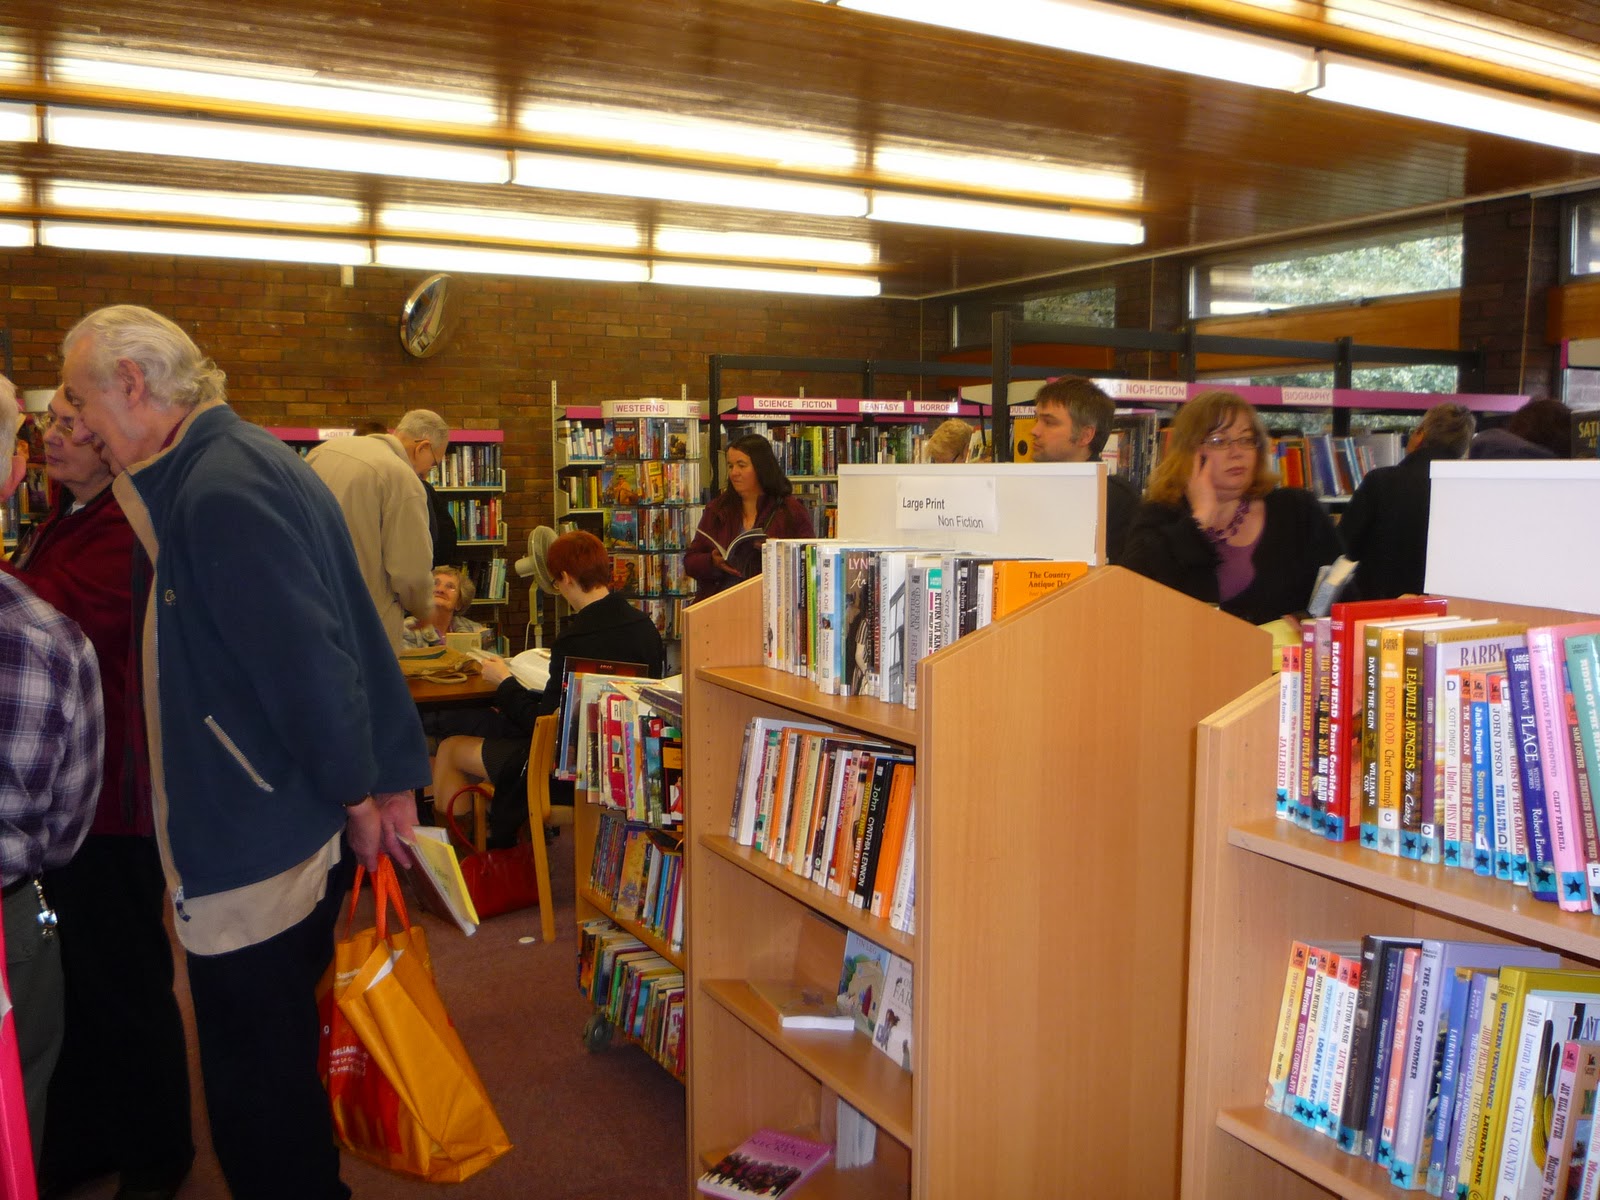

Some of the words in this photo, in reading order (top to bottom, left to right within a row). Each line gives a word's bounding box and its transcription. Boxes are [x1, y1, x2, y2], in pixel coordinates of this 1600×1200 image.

[1126, 384, 1185, 396] NON-FICTION
[1284, 391, 1330, 401] BIOGRAPHY
[616, 404, 665, 413] WESTERNS
[758, 400, 793, 408] SCIENCE
[801, 401, 832, 409] FICTION
[864, 403, 899, 411] FANTASY
[902, 497, 923, 511] Large
[925, 497, 945, 510] Print
[937, 515, 954, 527] Non
[956, 515, 984, 528] Fiction
[1028, 581, 1055, 589] Antique
[1043, 571, 1071, 580] Country
[1303, 648, 1313, 693] TODHUNTER
[1321, 656, 1330, 671] THE
[1331, 642, 1339, 686] BLOODY
[1512, 654, 1529, 664] LARGE
[1514, 663, 1529, 672] PRINT
[1447, 680, 1456, 691] D
[1580, 659, 1592, 692] RIDER
[1385, 686, 1396, 709] FORT
[1404, 668, 1419, 718] LEADVILLE
[1586, 694, 1595, 706] OF
[1302, 695, 1311, 730] BALLARD
[1448, 707, 1456, 728] SCOTT
[1474, 707, 1483, 727] Jake
[1492, 708, 1501, 739] JOHN
[1588, 707, 1598, 730] THE
[1319, 717, 1329, 734] THE
[1384, 713, 1395, 744] BLOOD
[1572, 727, 1581, 742] SAM
[1318, 739, 1328, 756] SKY
[1404, 720, 1417, 769] AVENGERS
[1448, 730, 1456, 757] DINGLEY
[1474, 729, 1484, 764] Douglas
[1520, 715, 1539, 763] PLACE
[1277, 736, 1287, 787] JAILBIRD
[1302, 738, 1310, 768] OUTLAW
[1494, 741, 1504, 777] DYSON
[1575, 743, 1585, 768] FOSTER
[1318, 758, 1328, 773] MAX
[1509, 756, 1518, 779] GUNS
[1301, 770, 1309, 796] BRAND
[1317, 777, 1327, 801] BRAND
[1328, 755, 1336, 803] Coolidge
[1405, 770, 1415, 791] Tom
[1462, 763, 1472, 794] Settlers
[1527, 769, 1535, 789] STORIES
[1533, 768, 1541, 791] WESTERN
[861, 782, 871, 814] SIMON
[870, 784, 881, 812] John
[1495, 785, 1505, 798] THE
[1553, 791, 1561, 814] CLIFF
[1578, 773, 1592, 811] NEMESIS
[1446, 803, 1455, 821] MISS
[1462, 807, 1472, 820] San
[1496, 800, 1506, 817] TALL
[1513, 797, 1521, 814] THE
[858, 814, 866, 836] KING
[1383, 813, 1391, 822] C
[1531, 808, 1545, 837] Robert
[1584, 813, 1595, 838] RIDES
[863, 817, 875, 851] CYNTHIA
[1422, 825, 1431, 835] C
[1498, 834, 1508, 845] D
[1555, 816, 1566, 851] FARRELL
[1587, 840, 1598, 859] THE
[858, 852, 869, 887] LENNON
[1592, 868, 1599, 877] F
[1309, 958, 1317, 967] M
[1305, 976, 1313, 987] Bill
[1314, 974, 1323, 993] JOHN
[1422, 967, 1431, 986] THE
[1300, 988, 1312, 1016] Morrison
[1310, 994, 1320, 1023] MURPHY
[1344, 992, 1356, 1024] CLAYTON
[1396, 988, 1410, 1025] Trigger
[1418, 989, 1428, 1015] GUNS
[1341, 1025, 1351, 1044] NASH
[1416, 1020, 1424, 1034] OF
[1494, 1002, 1507, 1049] WESTERN
[1294, 1023, 1306, 1053] REVENGE
[1393, 1028, 1405, 1051] Talk
[1447, 1029, 1458, 1059] LAURAN
[1521, 1033, 1536, 1065] Lauran
[1291, 1053, 1301, 1075] COMES
[1301, 1034, 1314, 1073] Cheyenne
[1410, 1035, 1422, 1080] SUMMER
[1444, 1060, 1454, 1082] PAINE
[1486, 1050, 1501, 1109] VENGEANCE
[1518, 1067, 1532, 1091] Paine
[1288, 1075, 1297, 1093] LATE
[1308, 1075, 1319, 1105] LEGACY
[1560, 1083, 1571, 1096] JAY
[1511, 1096, 1527, 1135] CACTUS
[1557, 1097, 1568, 1113] HILL
[1384, 1128, 1390, 1138] N
[1465, 1113, 1479, 1163] RENEGADE
[1479, 1115, 1490, 1154] LAURAN
[1553, 1114, 1566, 1140] POTTER
[1474, 1156, 1485, 1185] PAINE
[1503, 1137, 1521, 1185] COUNTRY
[1545, 1156, 1560, 1186] Murder
